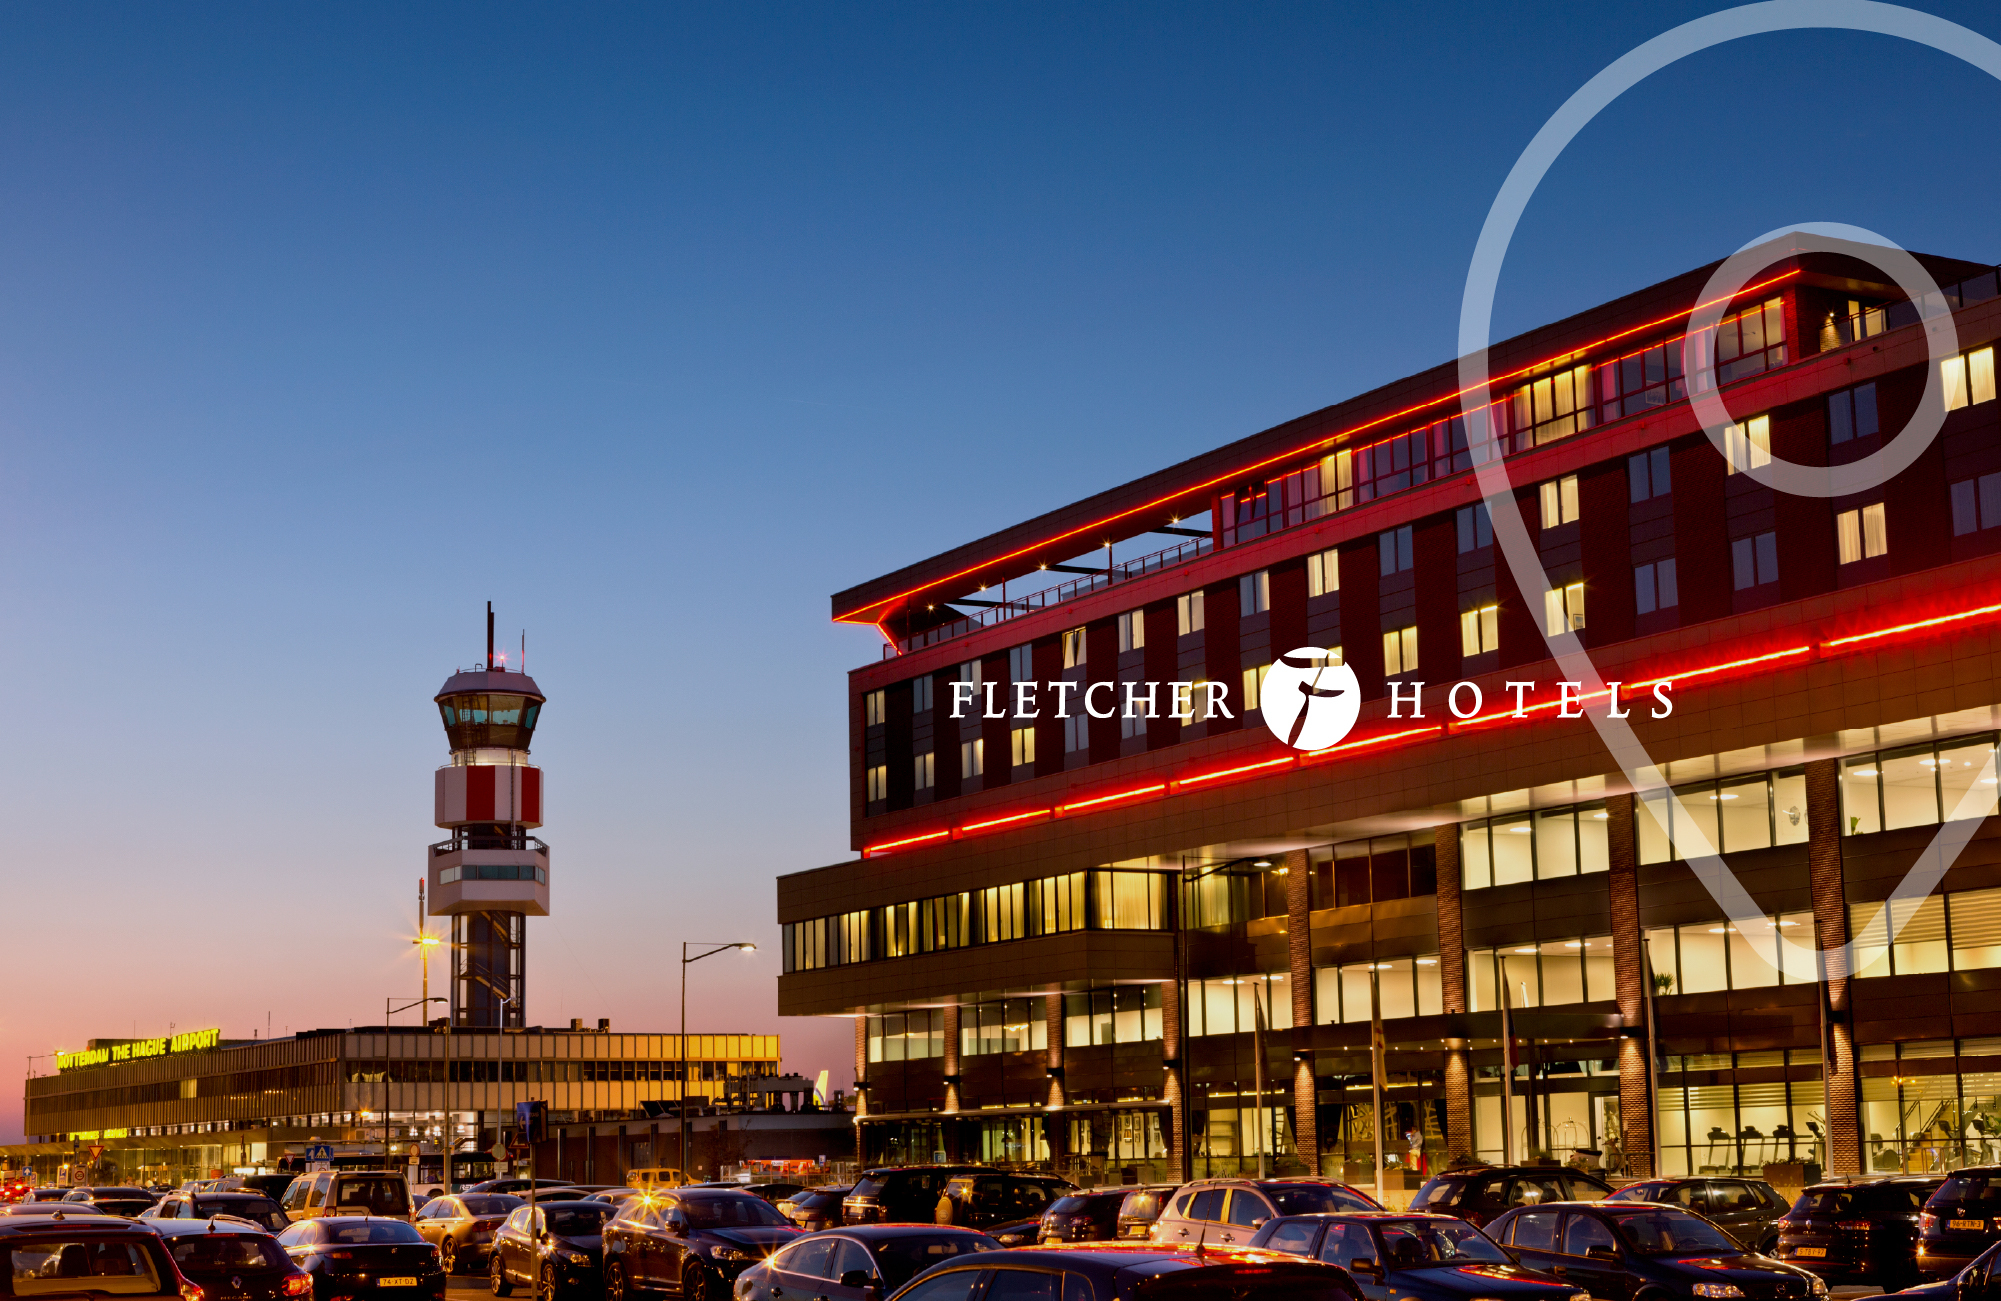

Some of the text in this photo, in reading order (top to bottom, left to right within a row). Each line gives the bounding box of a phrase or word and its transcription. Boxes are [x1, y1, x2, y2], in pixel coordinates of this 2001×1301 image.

[57, 1028, 219, 1070] ROTTERDAM THE HAGUE AIRPORT
